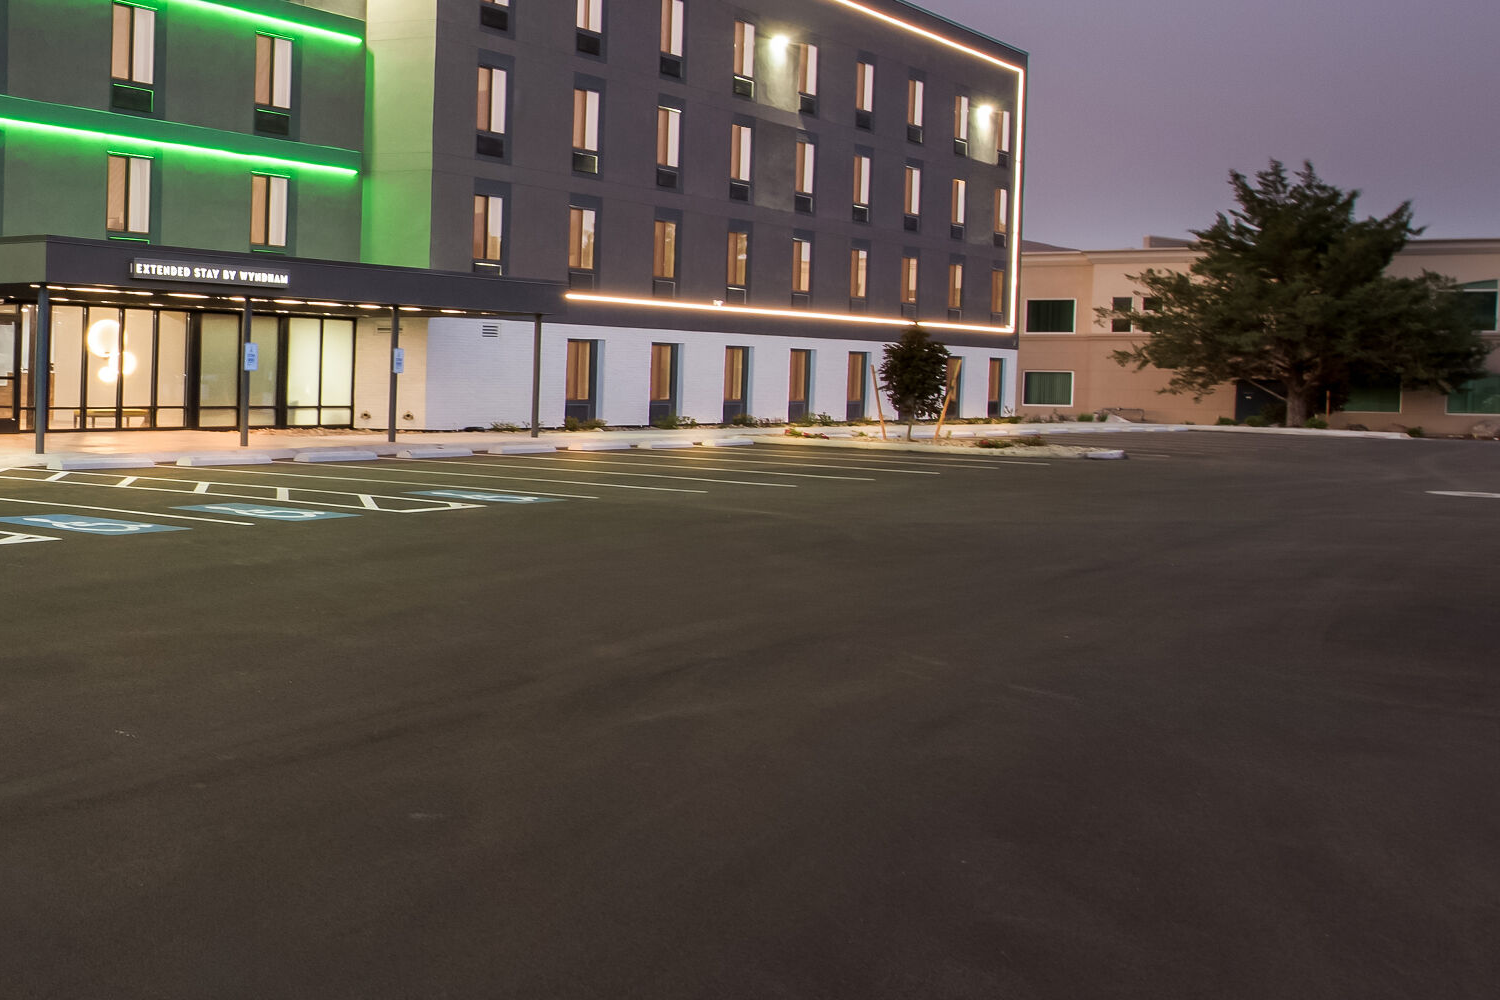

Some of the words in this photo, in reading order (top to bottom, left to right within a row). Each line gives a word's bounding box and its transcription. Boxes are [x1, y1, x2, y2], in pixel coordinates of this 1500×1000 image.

[135, 263, 191, 277] EXTENDED
[193, 267, 220, 279] STAY
[223, 269, 237, 280] BY
[239, 270, 289, 284] WYNDHAM
